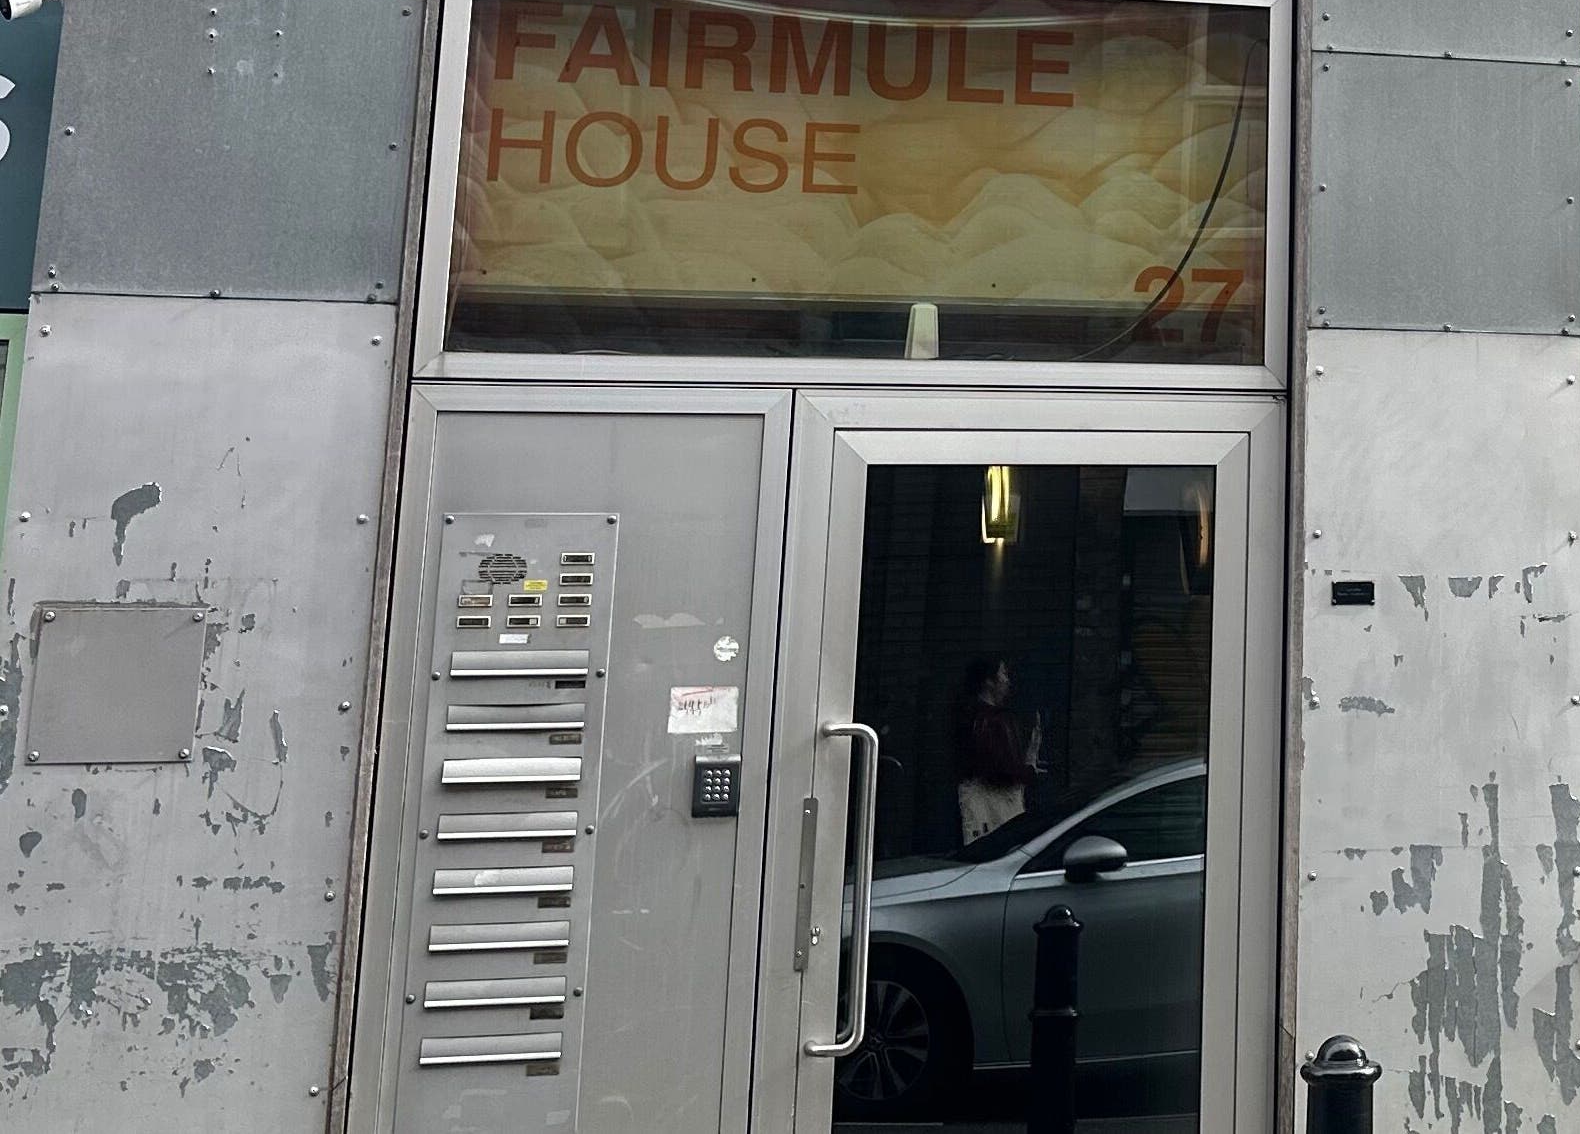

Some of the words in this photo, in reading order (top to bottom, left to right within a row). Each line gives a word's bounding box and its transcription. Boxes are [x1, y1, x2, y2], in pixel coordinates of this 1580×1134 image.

[494, 0, 1074, 107] FAIRMULE
[486, 108, 861, 195] HOUSE
[1134, 266, 1244, 343] 27
